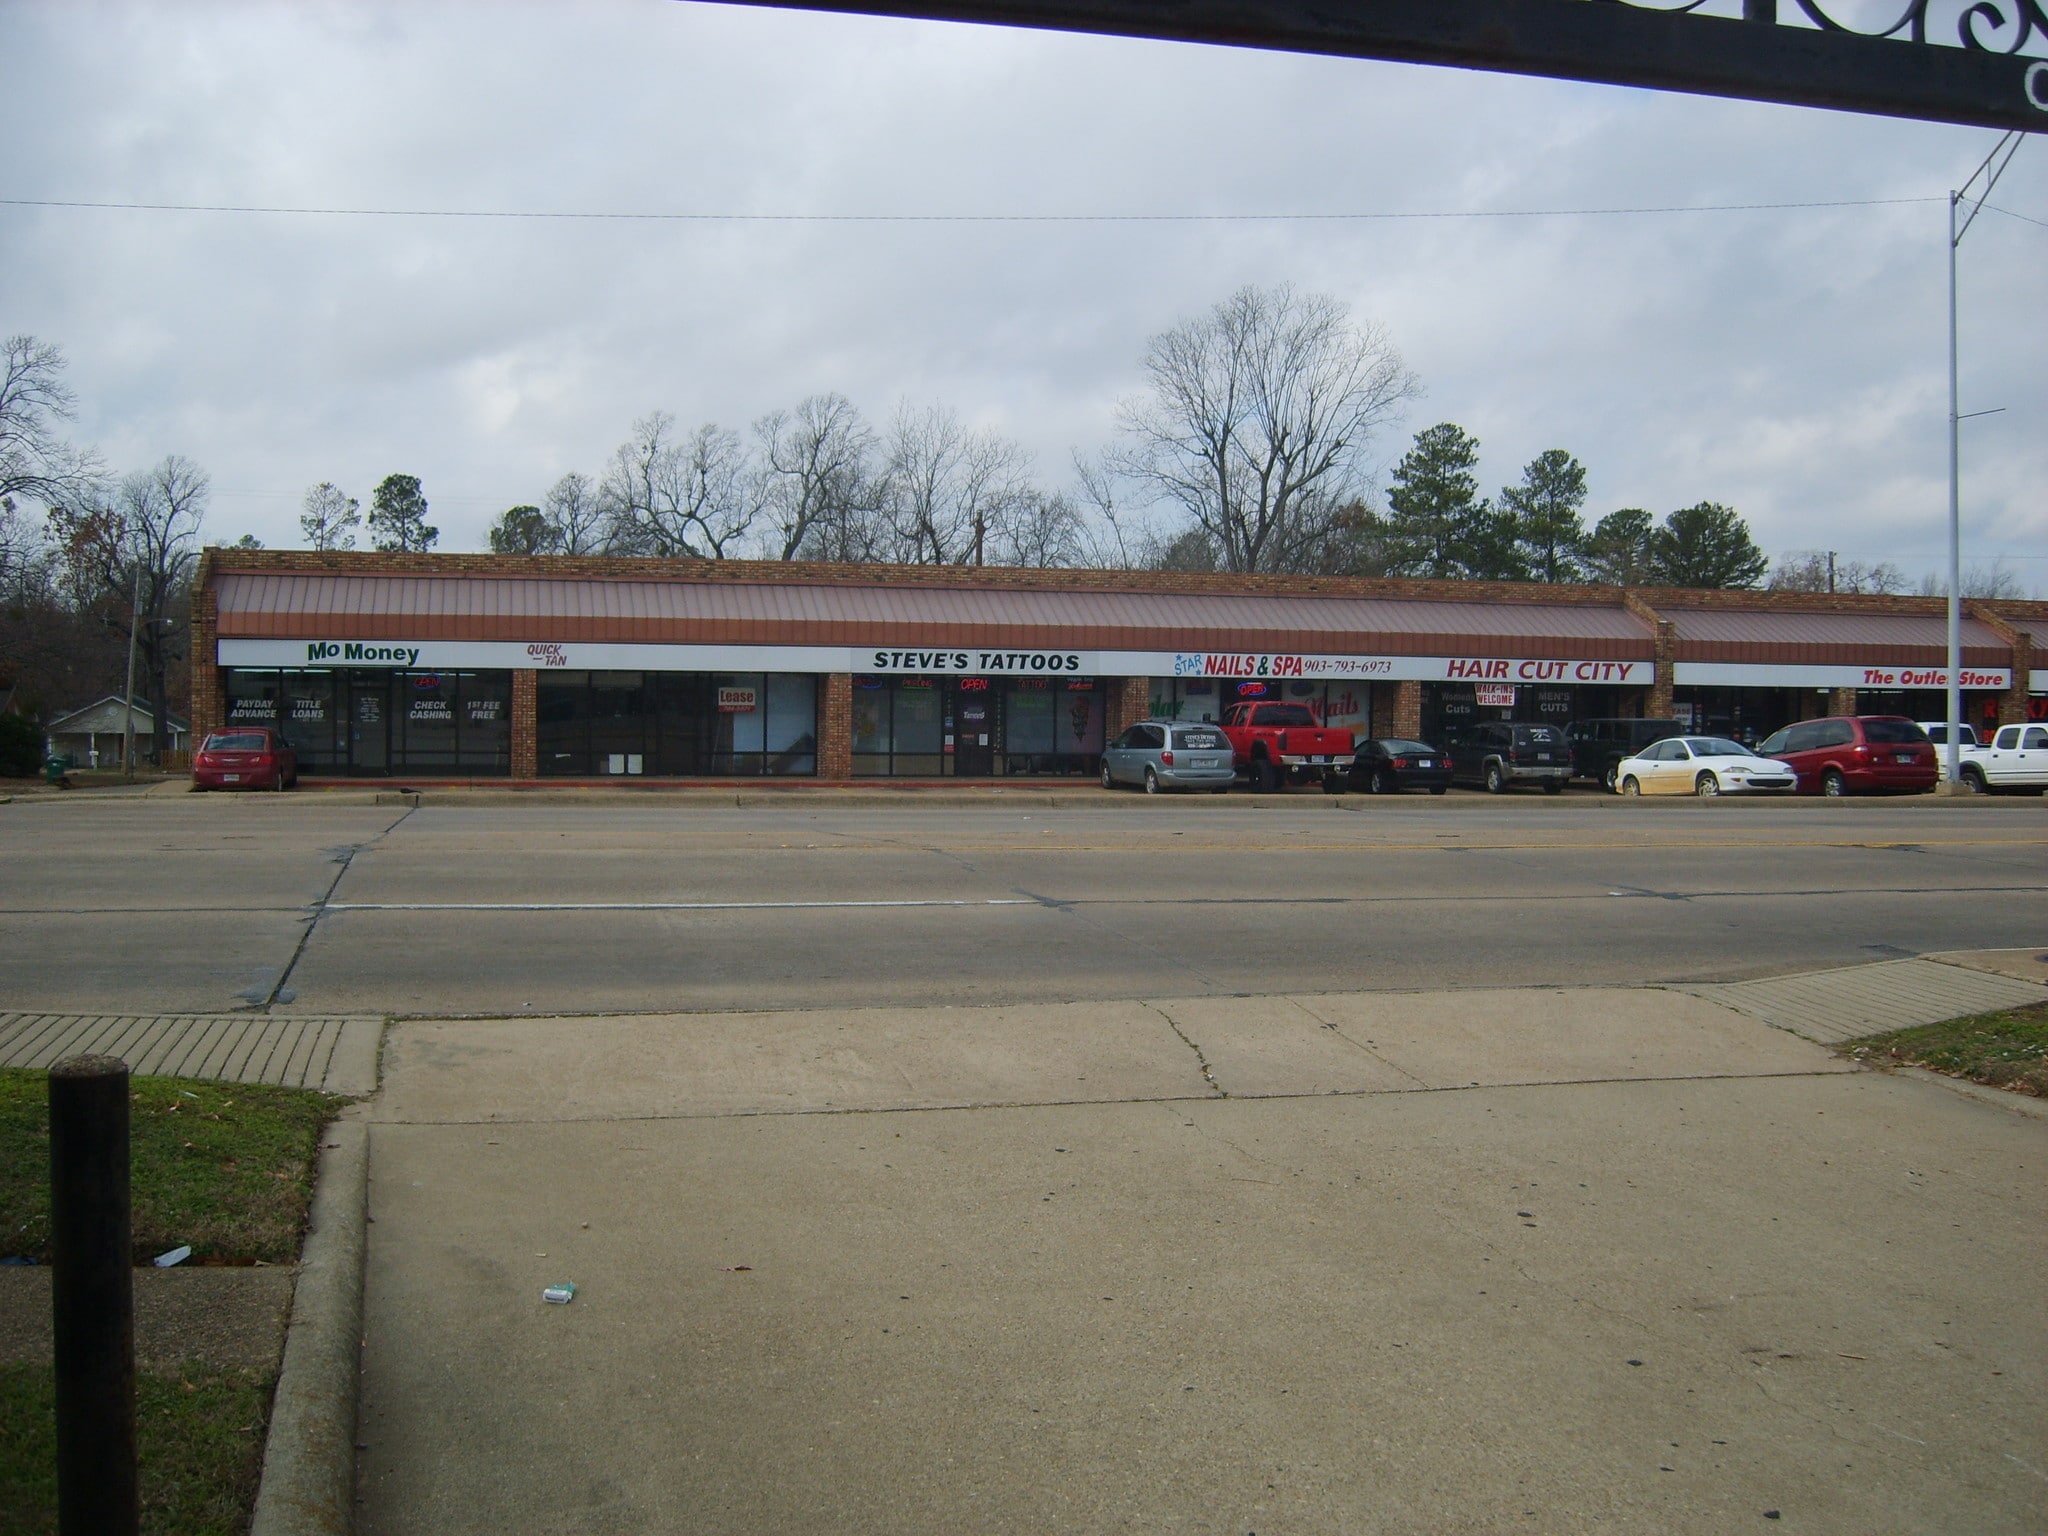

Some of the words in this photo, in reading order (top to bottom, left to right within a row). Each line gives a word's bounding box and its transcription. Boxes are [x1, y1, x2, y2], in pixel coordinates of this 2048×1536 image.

[308, 642, 340, 660] Mo
[344, 643, 419, 666] Money
[527, 644, 562, 656] QUICK
[545, 655, 568, 666] TAN
[873, 652, 968, 669] STEVE'S
[979, 654, 1079, 670] TATTOOS
[1174, 655, 1203, 676] STAR
[1204, 655, 1255, 676] NAILS
[1257, 656, 1268, 676] &
[1272, 656, 1303, 676] SPA
[1304, 659, 1391, 674] 903-793-6973
[1447, 660, 1509, 678] HAIR
[1518, 662, 1568, 679] CUT
[1575, 663, 1633, 681] CITY
[1863, 670, 1895, 684] The
[1900, 671, 1949, 685] Outle
[1959, 671, 2003, 685] Store
[960, 678, 989, 690] OPEN
[1476, 684, 1514, 694] WALK-INS
[1240, 684, 1263, 695] OPEN
[720, 689, 753, 702] Lease
[1476, 694, 1513, 704] WELCOME
[1538, 692, 1570, 701] MEN'S
[236, 700, 274, 708] PAYDAY
[296, 700, 321, 708] TITLE
[414, 701, 447, 709] CHECK
[482, 701, 500, 709] FEE
[1446, 704, 1471, 713] Cuts
[1540, 703, 1569, 712] CUTS
[231, 709, 278, 718] ADVANCE
[292, 709, 324, 718] LOANS
[410, 710, 451, 719] CASHING
[471, 710, 495, 719] FREE
